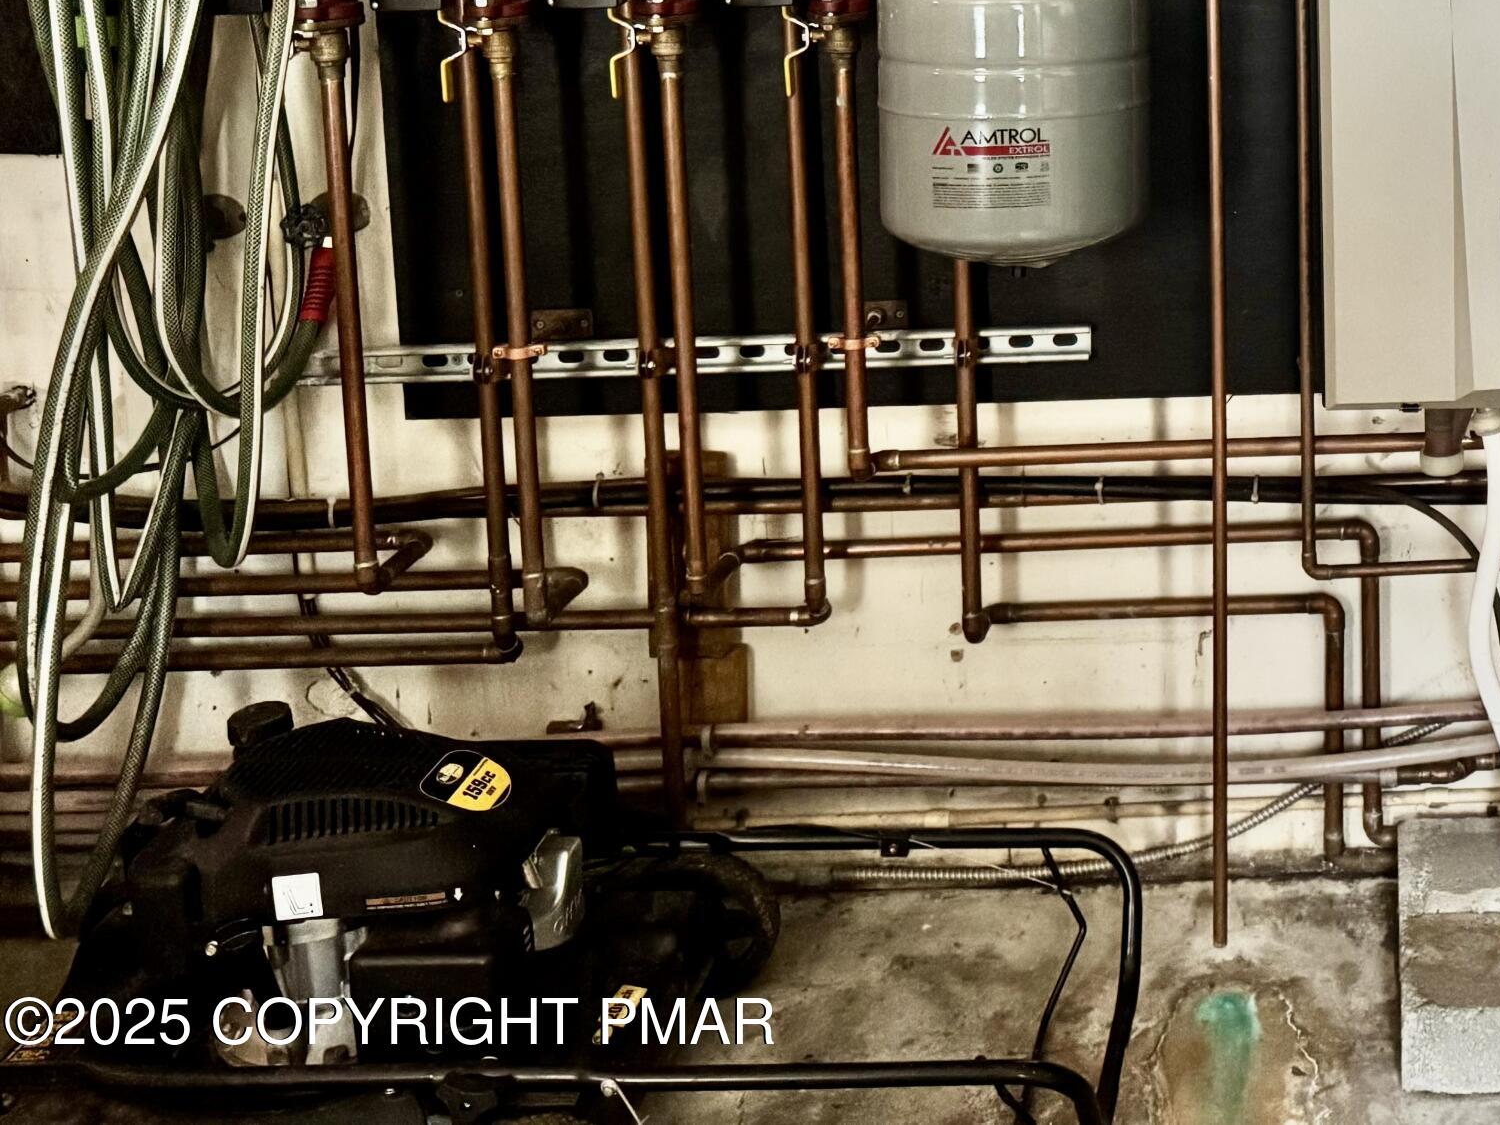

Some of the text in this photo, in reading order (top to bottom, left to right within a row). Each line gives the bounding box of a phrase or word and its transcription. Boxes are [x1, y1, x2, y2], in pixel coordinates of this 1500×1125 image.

[960, 127, 1050, 145] AMTROL
[1008, 144, 1049, 155] EXTROL
[462, 770, 496, 800] 159cc
